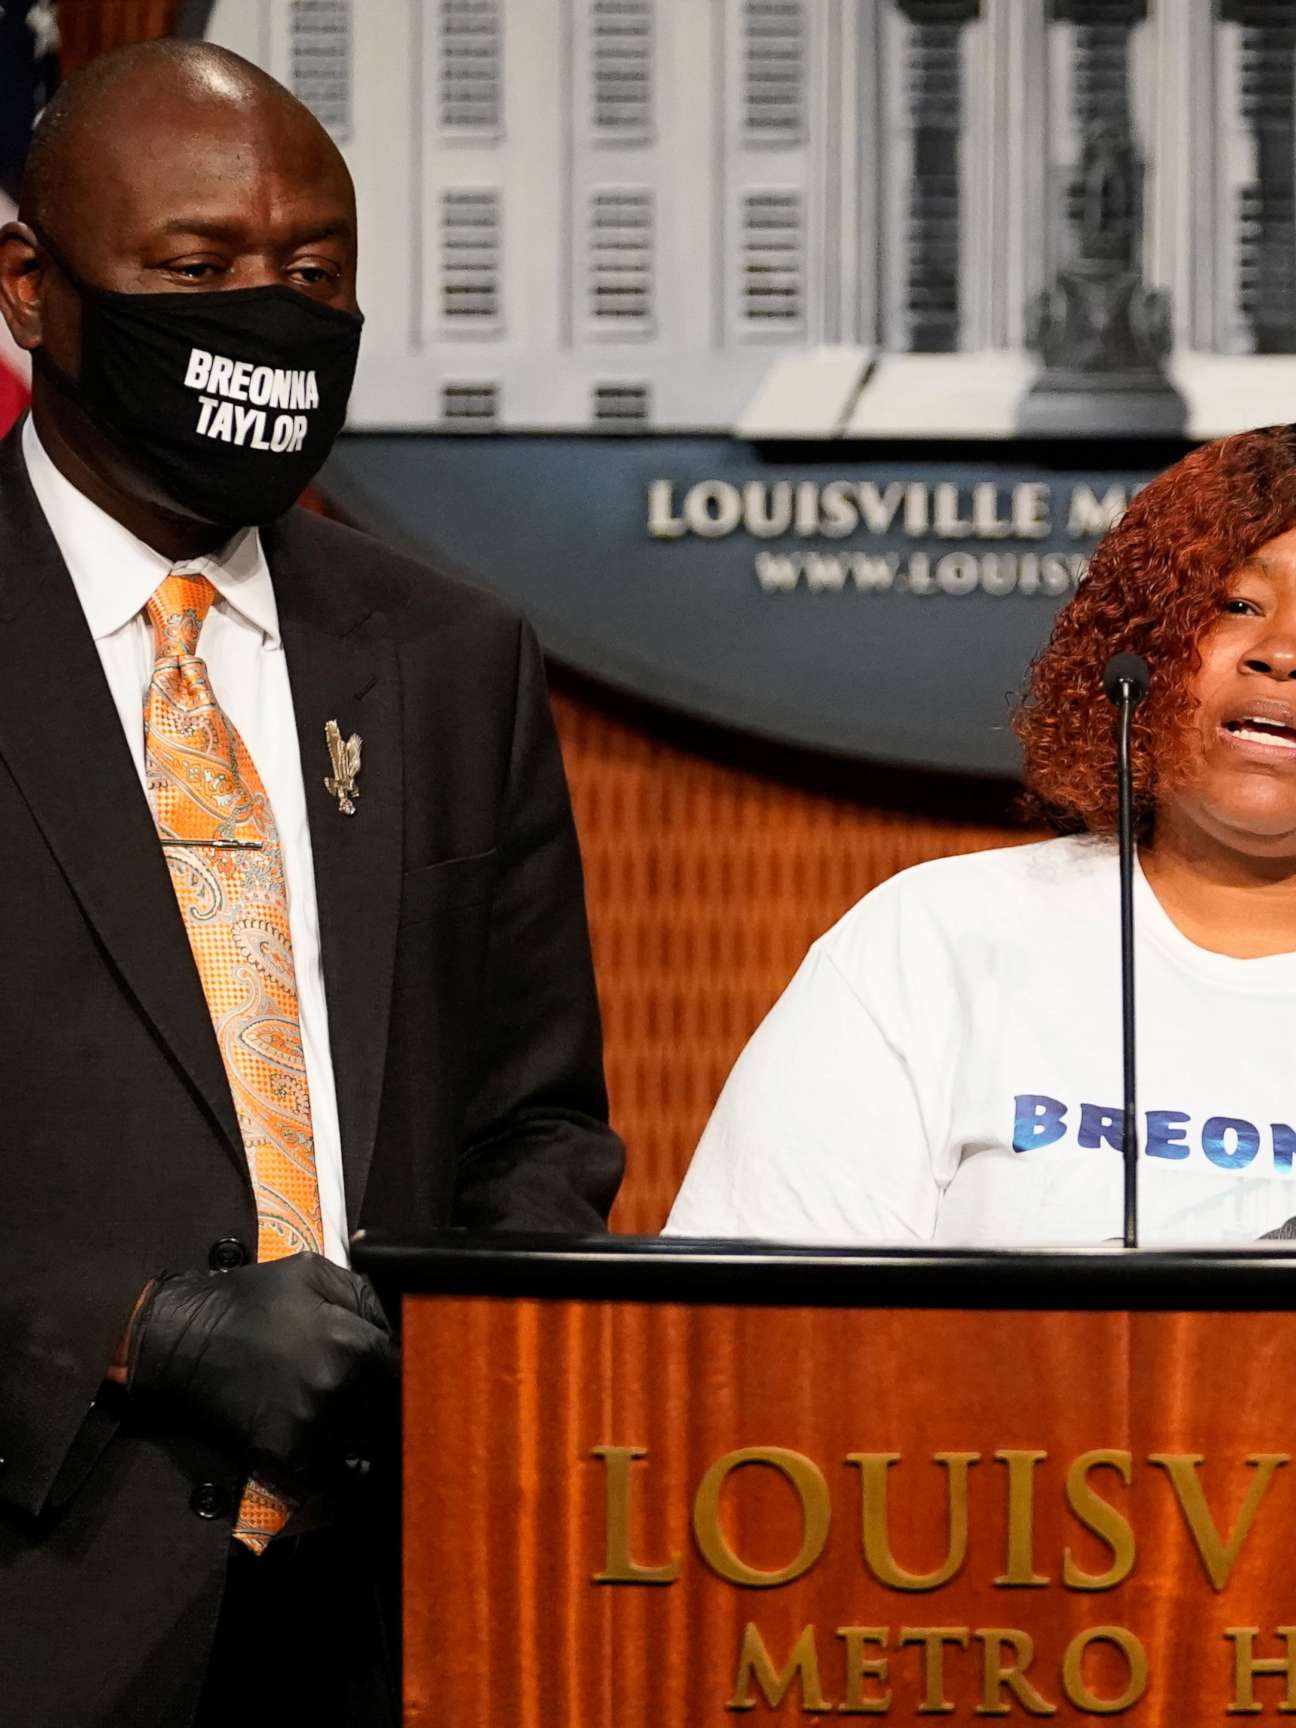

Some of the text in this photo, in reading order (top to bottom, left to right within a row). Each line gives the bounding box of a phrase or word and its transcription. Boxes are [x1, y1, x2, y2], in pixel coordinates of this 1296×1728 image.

[183, 348, 320, 410] BREONNA
[195, 396, 308, 453] TAYLOR
[648, 479, 1051, 540] LOUISVILLE
[725, 1621, 1150, 1714] METRO
